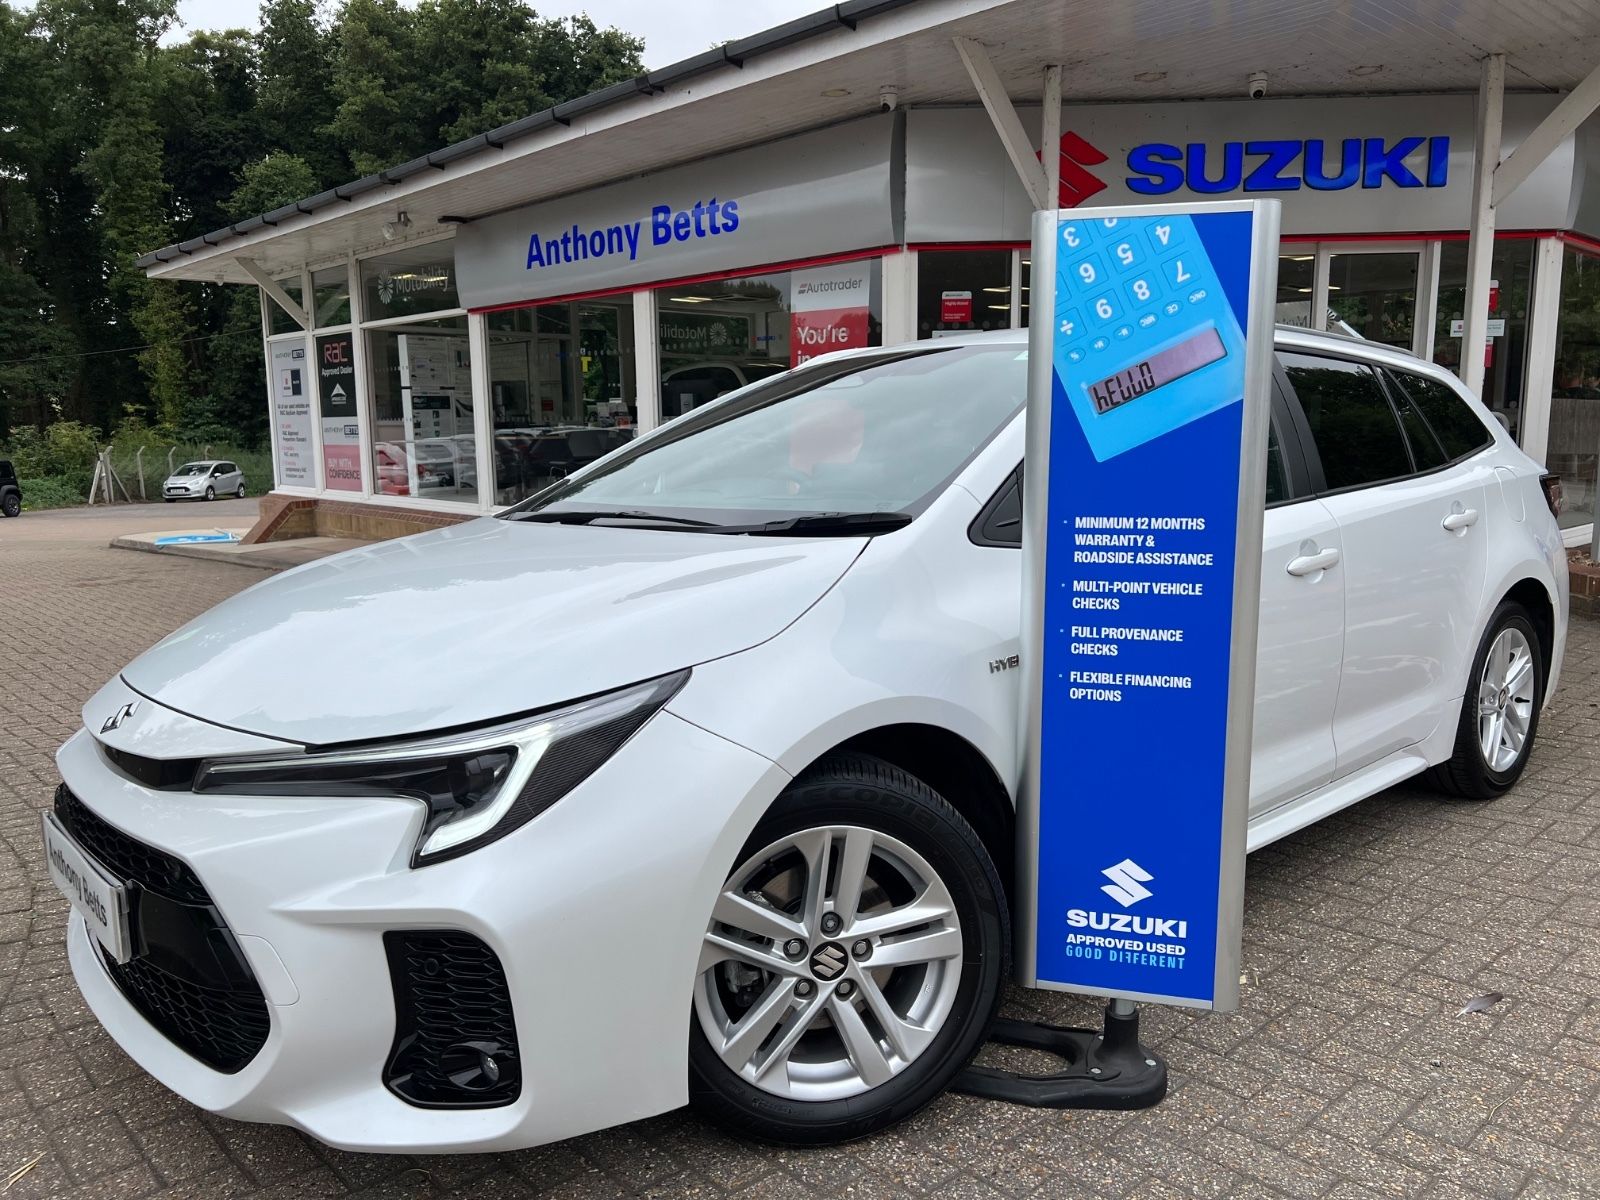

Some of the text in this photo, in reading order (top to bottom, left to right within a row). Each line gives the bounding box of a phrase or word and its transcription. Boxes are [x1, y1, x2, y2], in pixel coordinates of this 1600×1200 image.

[1126, 136, 1450, 195] SUZUKI
[526, 197, 739, 270] Anthony Betts
[396, 265, 449, 295] Motability
[806, 278, 863, 294] Autotrader
[797, 325, 849, 346] You're
[329, 469, 361, 480] CONFIDENCE
[1075, 516, 1206, 530] MINIMUM 12 MONTHS
[1075, 533, 1155, 547] WARRANTY &
[1074, 551, 1213, 566] ROADSIDE ASSISTANCE
[1073, 580, 1203, 595] MULTI-POINT VEHICLE
[1072, 597, 1120, 610] CHECKS
[1071, 626, 1183, 642] FULL PROVENANCE
[1070, 643, 1118, 656] CHECKS
[1070, 671, 1192, 688] FLEXIBLE FINANCING
[1069, 687, 1122, 702] OPTIONS
[82, 875, 108, 927] Betts
[1066, 909, 1187, 939] SUZUKI
[1066, 933, 1186, 956] APPROVED USED
[1066, 945, 1186, 970] GOOD DIFFERENT
